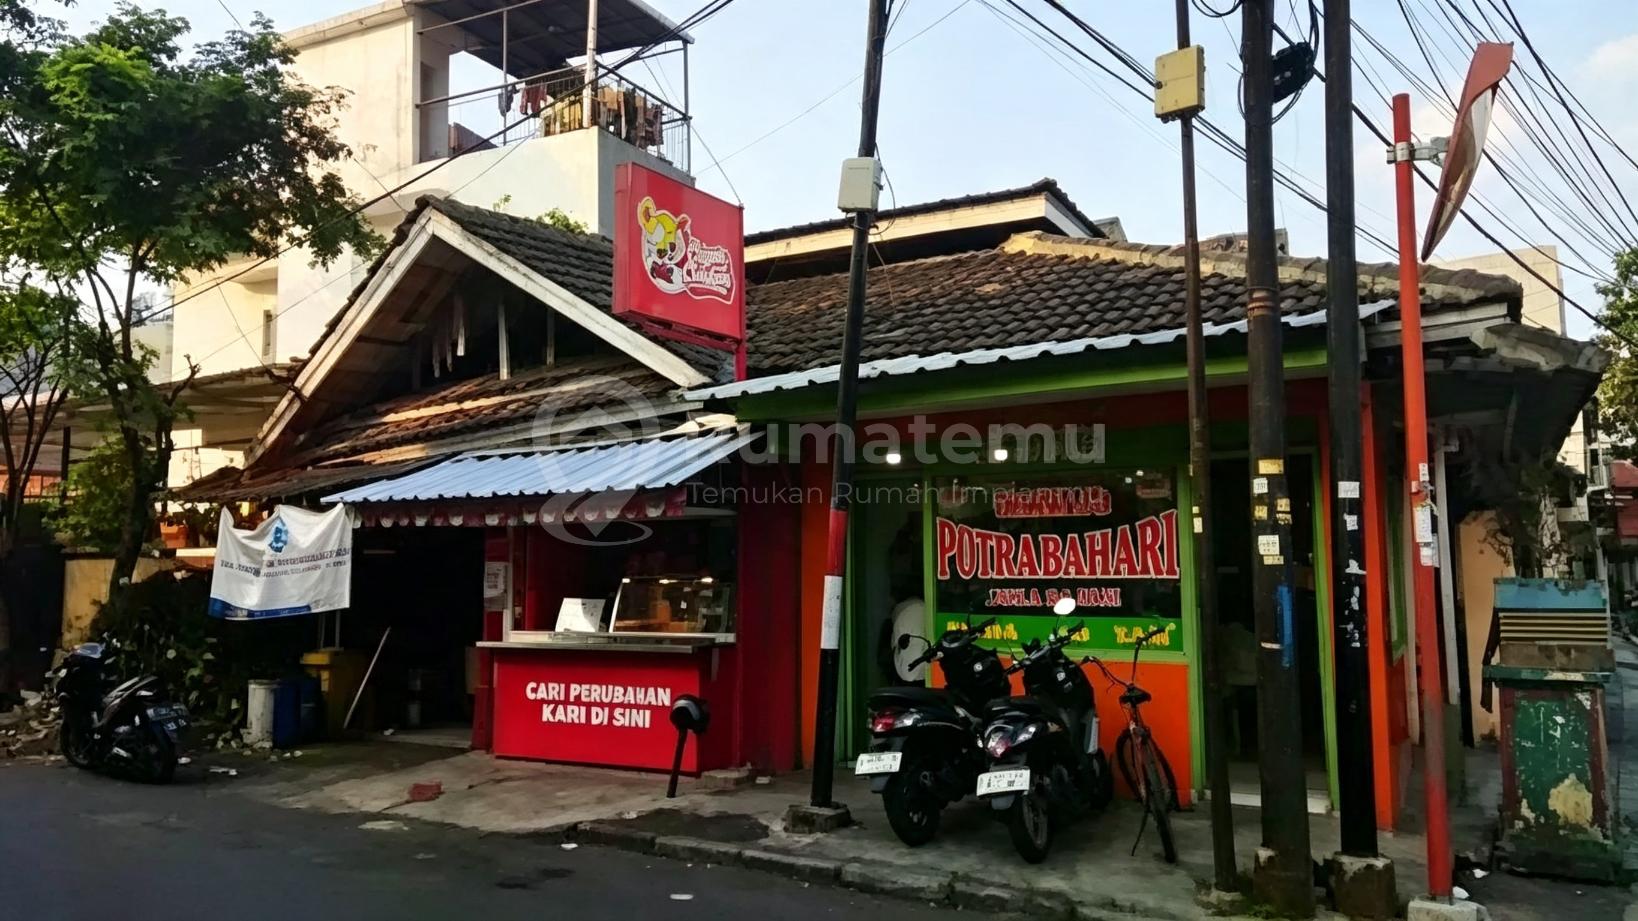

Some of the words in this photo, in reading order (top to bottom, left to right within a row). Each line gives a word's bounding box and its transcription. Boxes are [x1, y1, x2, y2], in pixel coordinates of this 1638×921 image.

[526, 682, 565, 702] CARI
[570, 684, 671, 707] PERUBAHAN
[542, 704, 586, 724] KARI
[591, 707, 608, 726] DI
[612, 709, 651, 729] SINI
